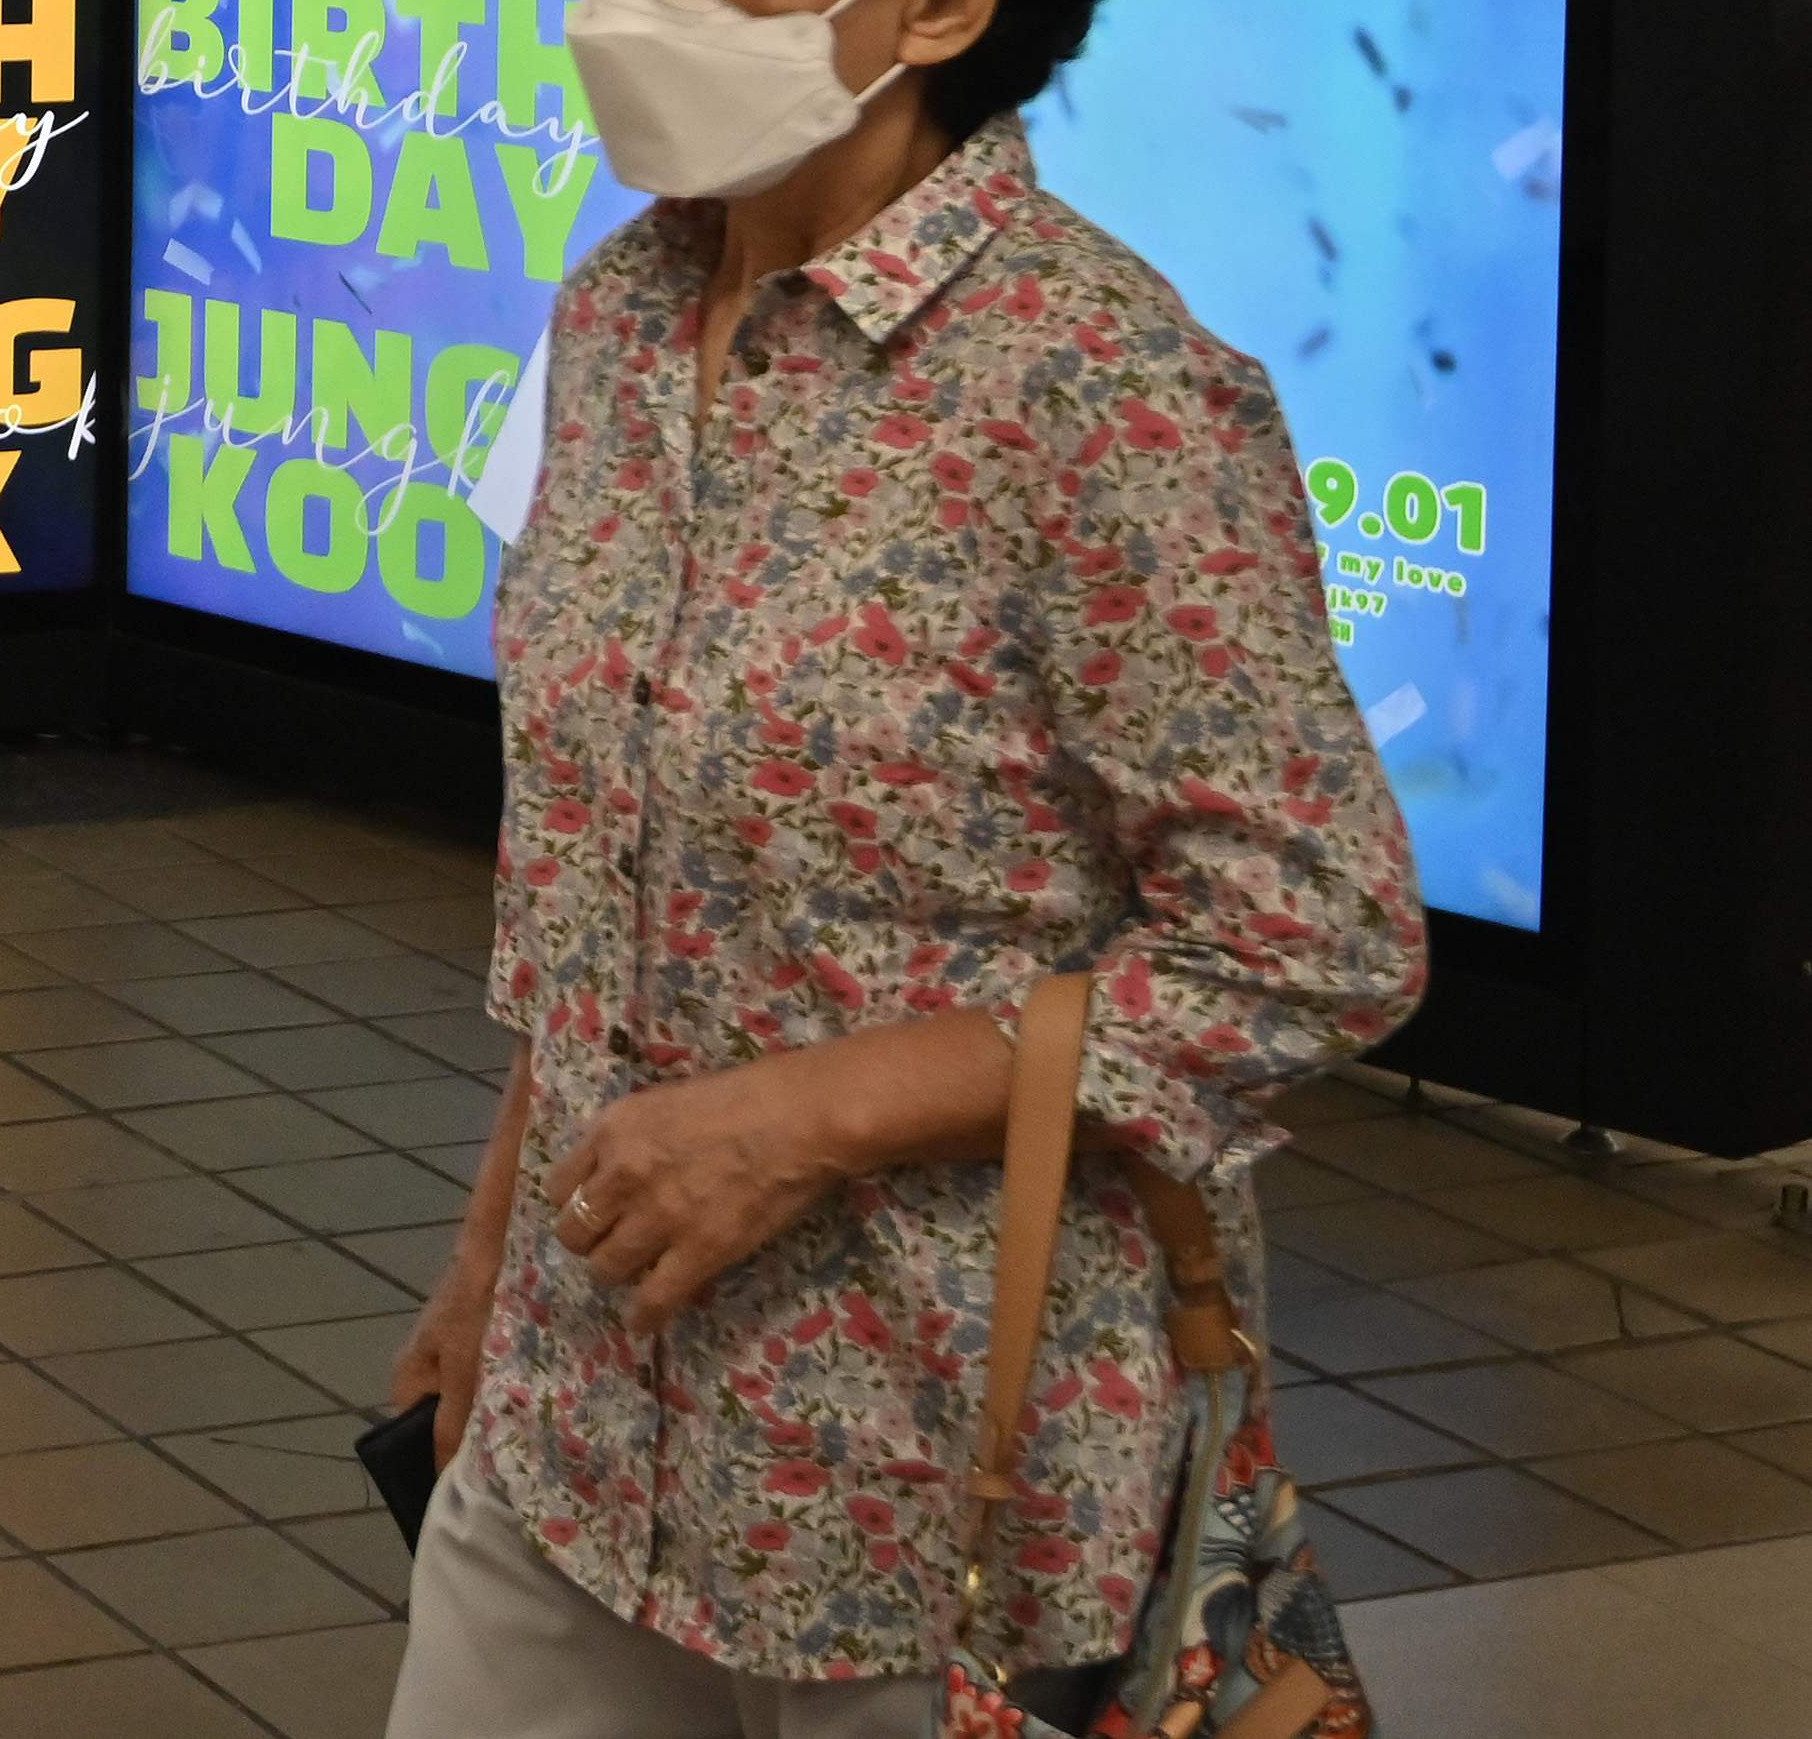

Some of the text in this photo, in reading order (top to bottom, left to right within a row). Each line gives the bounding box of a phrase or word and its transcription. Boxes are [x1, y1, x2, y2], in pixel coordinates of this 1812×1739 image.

[137, 6, 601, 199] birthday
[270, 111, 600, 282] DAY
[128, 370, 511, 536] jungk
[136, 288, 521, 479] JUNG
[168, 433, 486, 619] KOO
[1337, 551, 1384, 584] my
[1393, 556, 1466, 597] love
